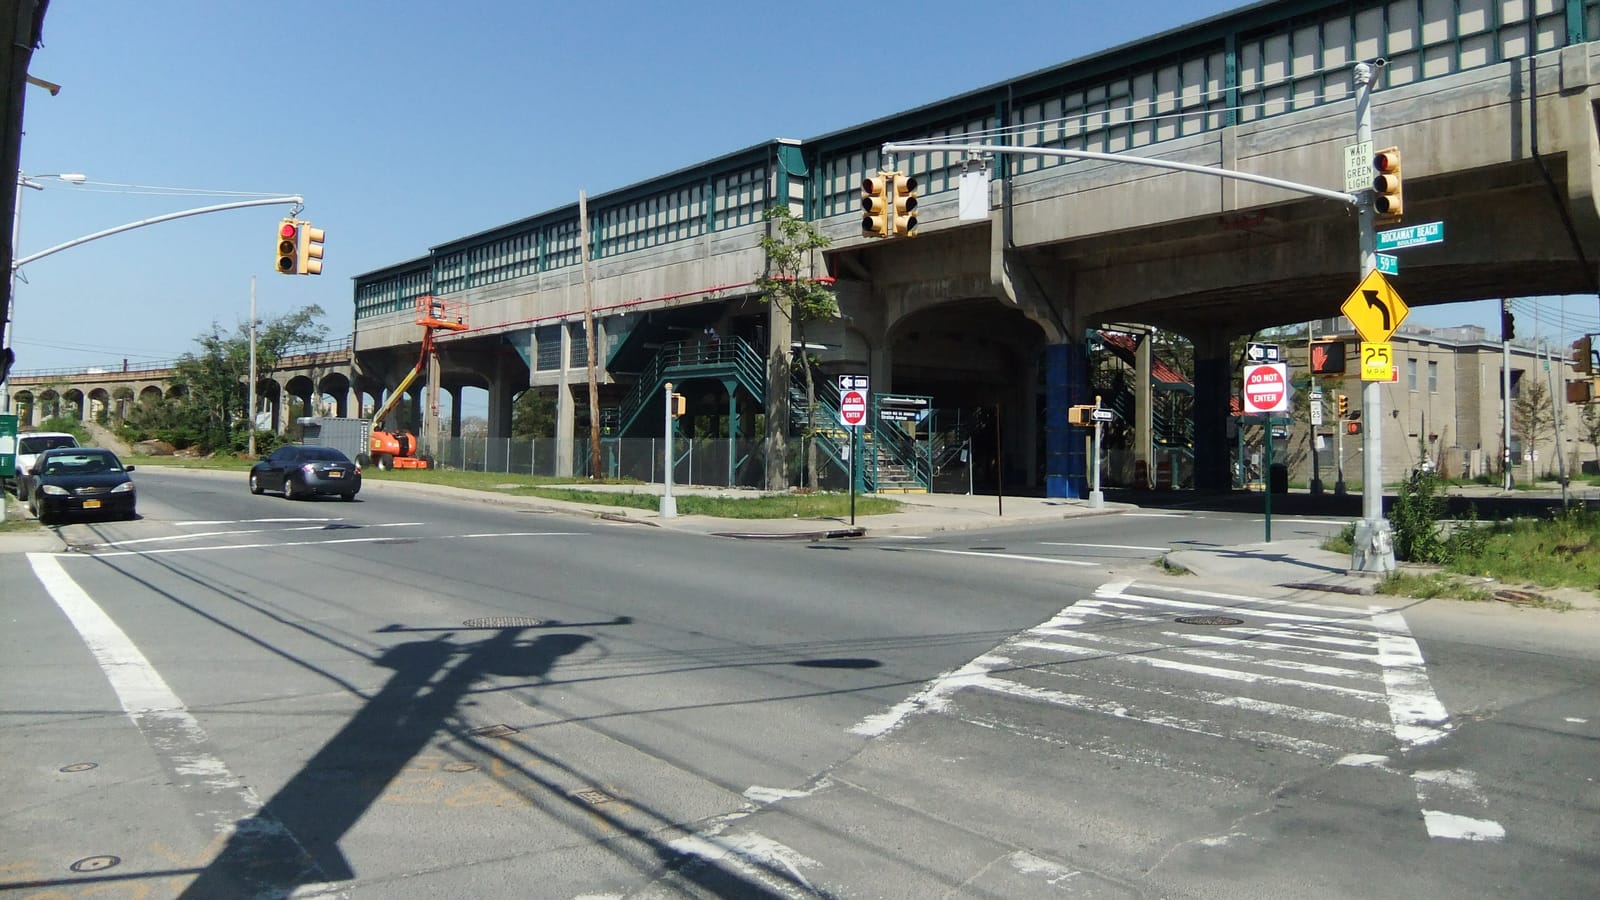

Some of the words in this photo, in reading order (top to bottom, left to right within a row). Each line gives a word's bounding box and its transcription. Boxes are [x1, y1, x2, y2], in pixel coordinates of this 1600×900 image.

[1350, 145, 1367, 156] WAIT
[1351, 157, 1366, 167] FOR
[1346, 167, 1372, 179] GREEN
[1348, 178, 1371, 190] LIGHT
[1381, 229, 1414, 243] ROCKAWAY
[1416, 224, 1438, 237] BEACH
[1380, 257, 1390, 270] 59
[1365, 347, 1389, 365] 25
[1251, 375, 1262, 383] DO
[1263, 373, 1278, 382] NOT
[1253, 394, 1277, 403] ENTER
[1312, 410, 1320, 418] 25
